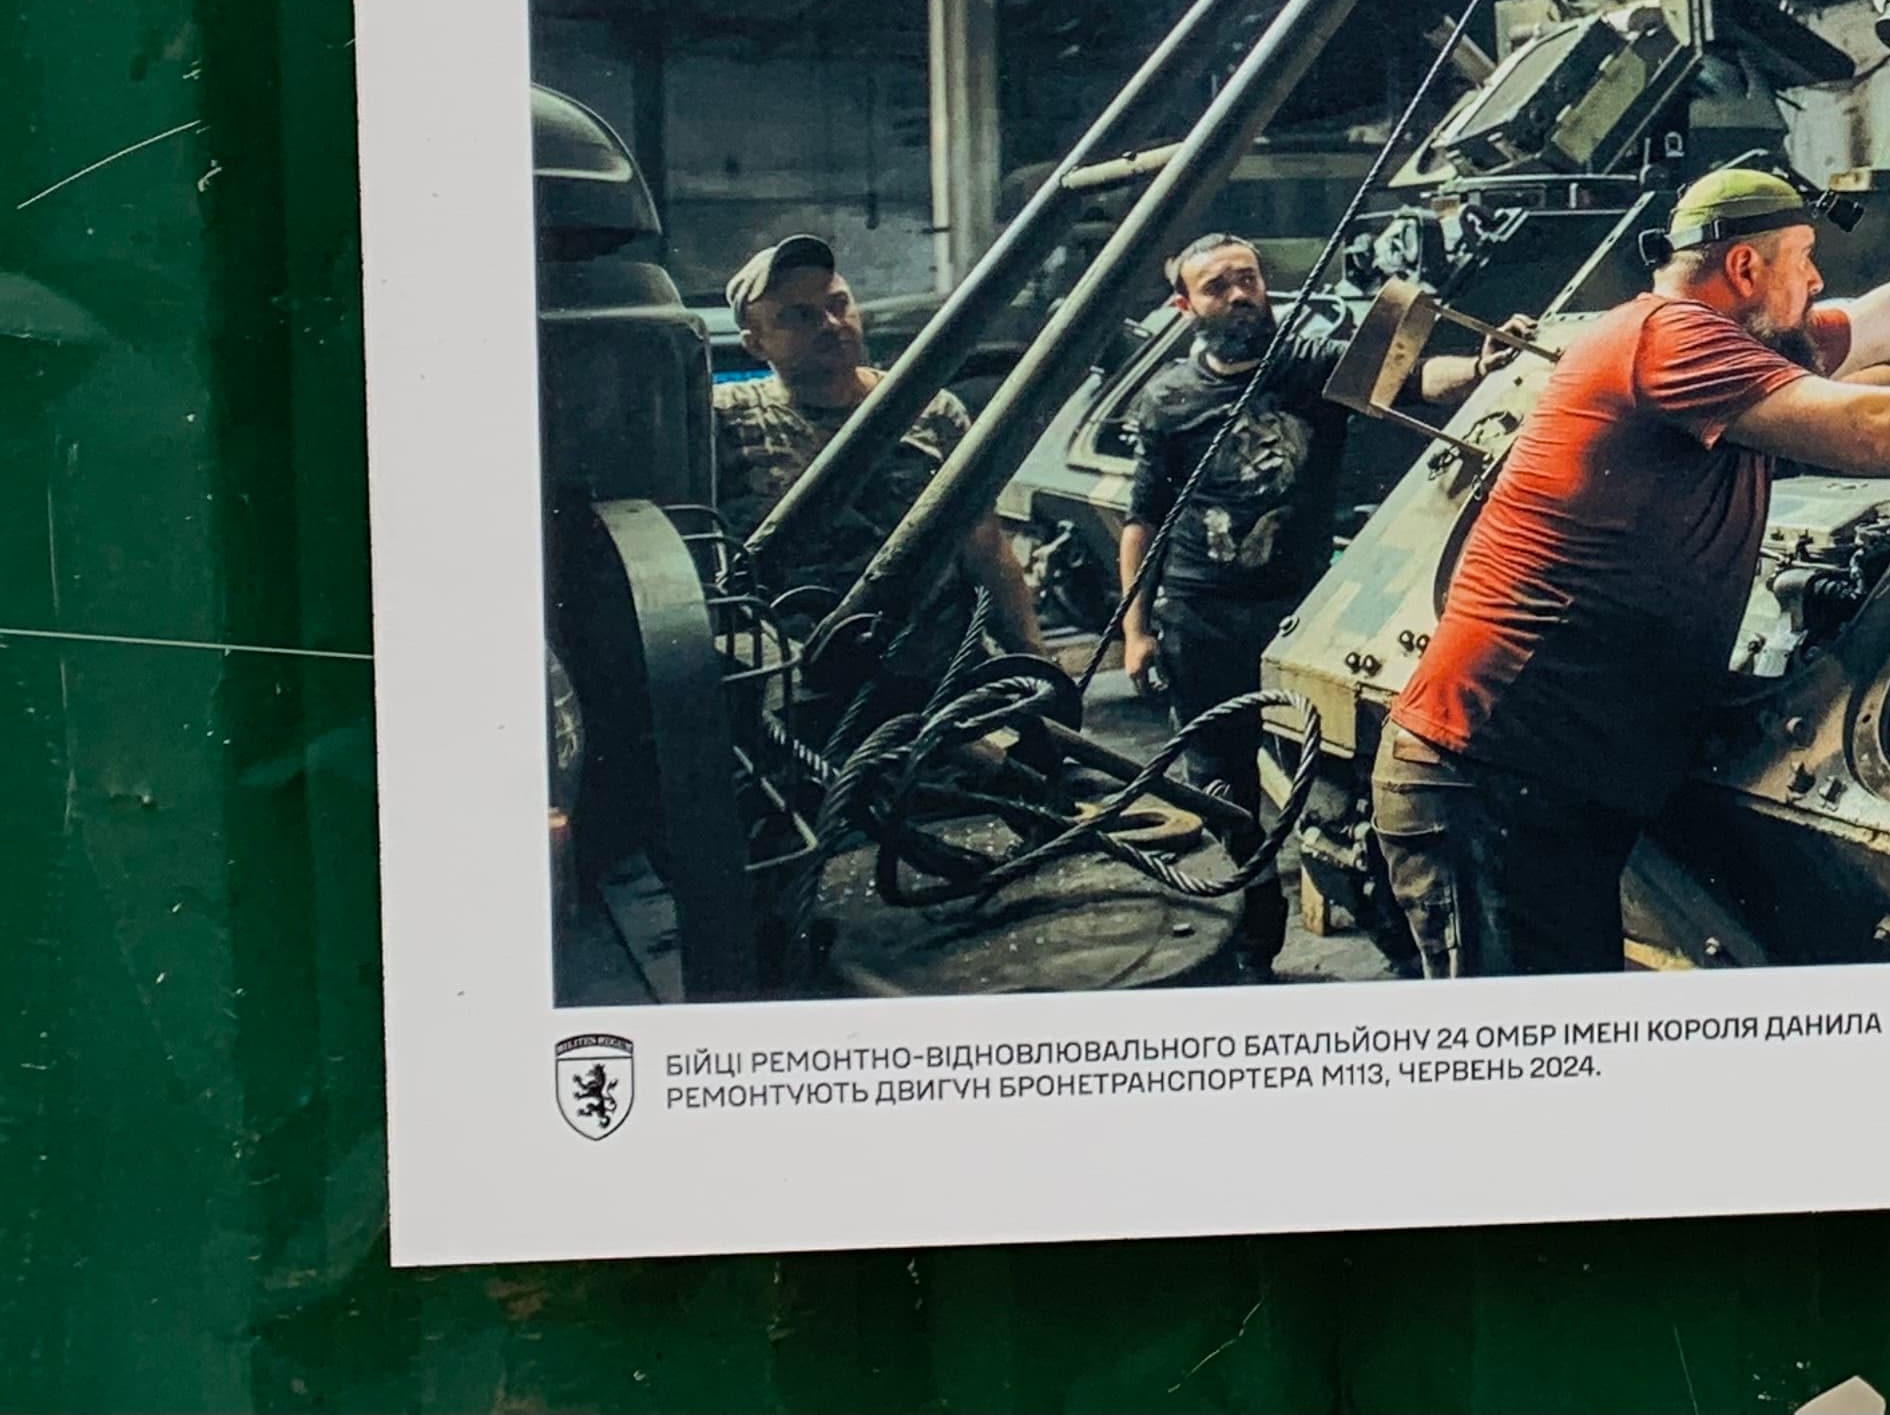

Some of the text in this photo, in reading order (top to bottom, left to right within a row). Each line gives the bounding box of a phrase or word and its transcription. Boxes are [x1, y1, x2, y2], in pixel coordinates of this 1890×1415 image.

[667, 1013, 1882, 1078] БІЙЦІ РЕМОНТНО-ВІДНОВЛЮВАЛЬНОГО БАТАЛЬЙОНУ 24 ОМБР ІМЕНІ КОРОЛЯ ДАНИЛА
[667, 1082, 869, 1109] РЕМОНТУЮТЬ
[875, 1077, 990, 1105] ДВИГУН
[999, 1065, 1313, 1098] БРОНЕТРАНСПОРТЕРА
[1399, 1058, 1524, 1083] ЧЕРВЕНЬ
[1530, 1055, 1601, 1079] 2024.
